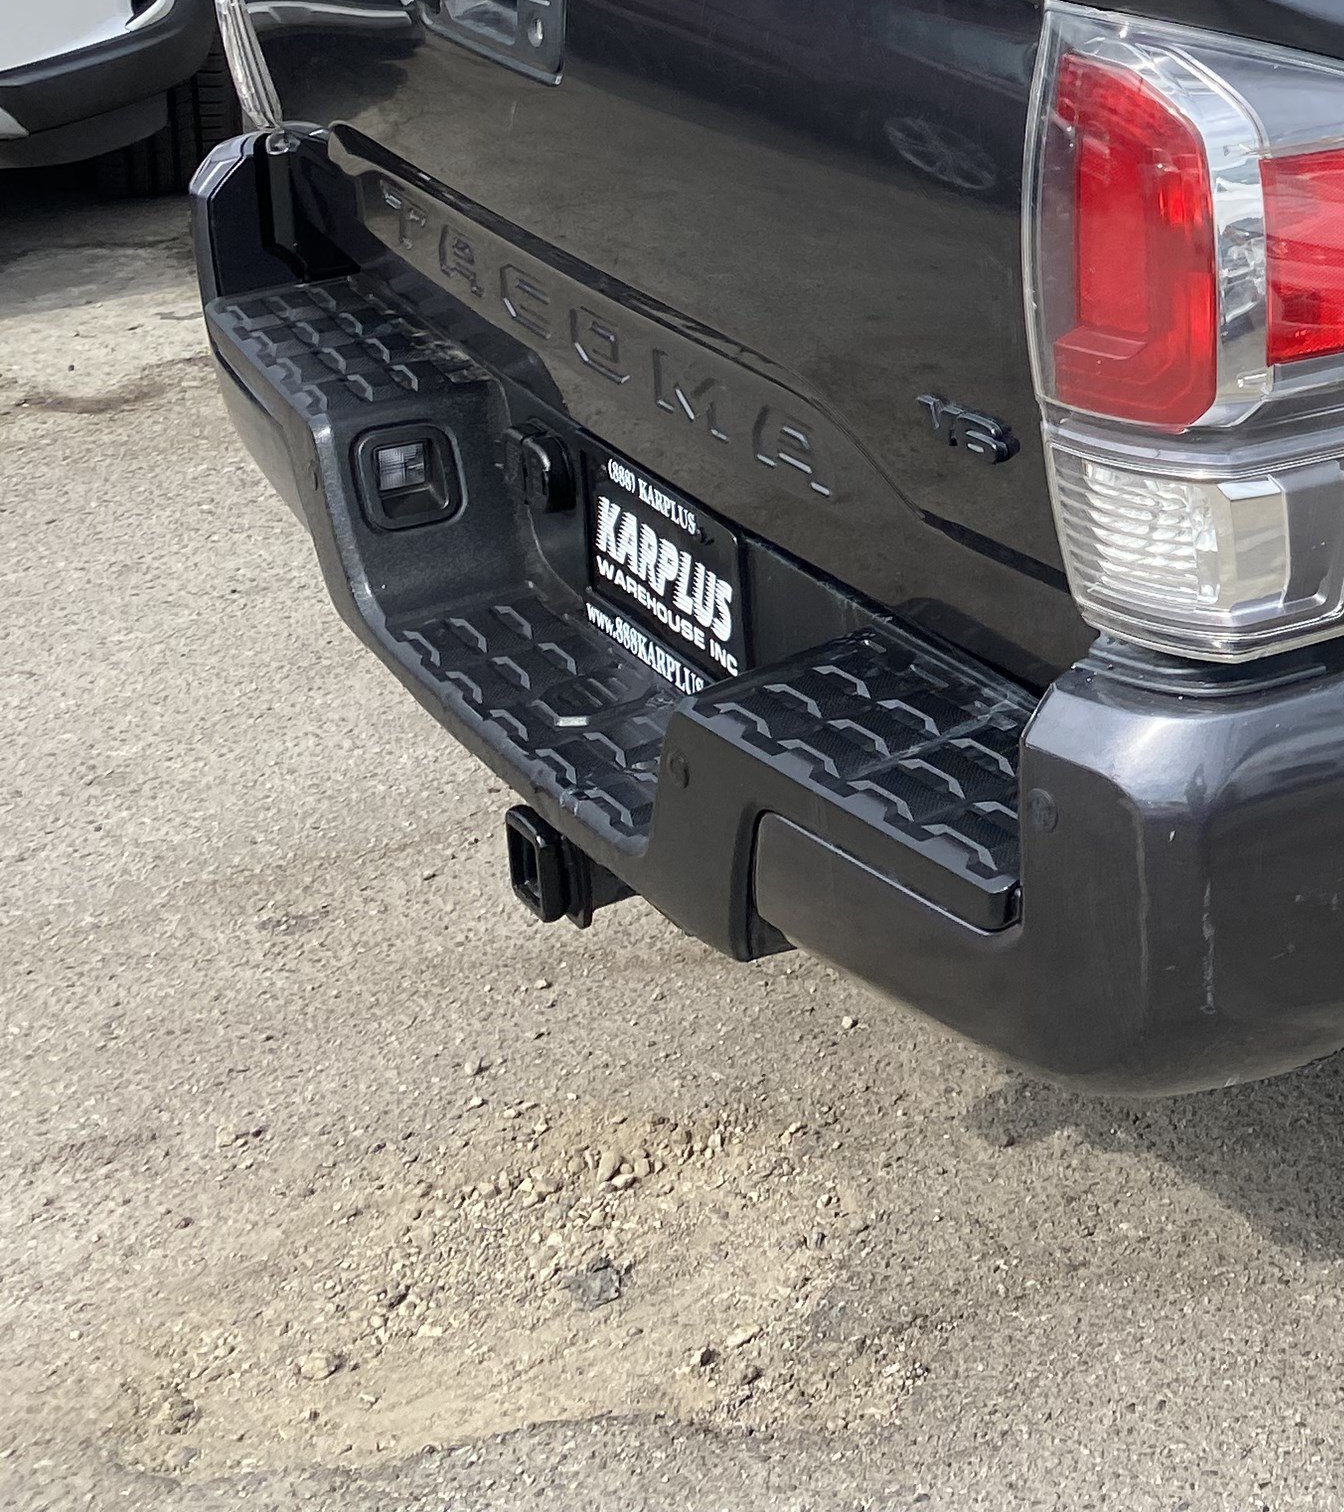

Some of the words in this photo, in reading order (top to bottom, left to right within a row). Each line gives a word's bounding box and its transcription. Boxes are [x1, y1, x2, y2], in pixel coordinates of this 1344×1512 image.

[379, 178, 832, 498] TACOMA
[916, 394, 1021, 465] V6
[607, 458, 636, 494] (888)
[637, 477, 697, 536] KARPLUS
[595, 495, 733, 643] KARPLUS
[596, 554, 706, 651] WAREHOUSE
[709, 638, 739, 677] INC
